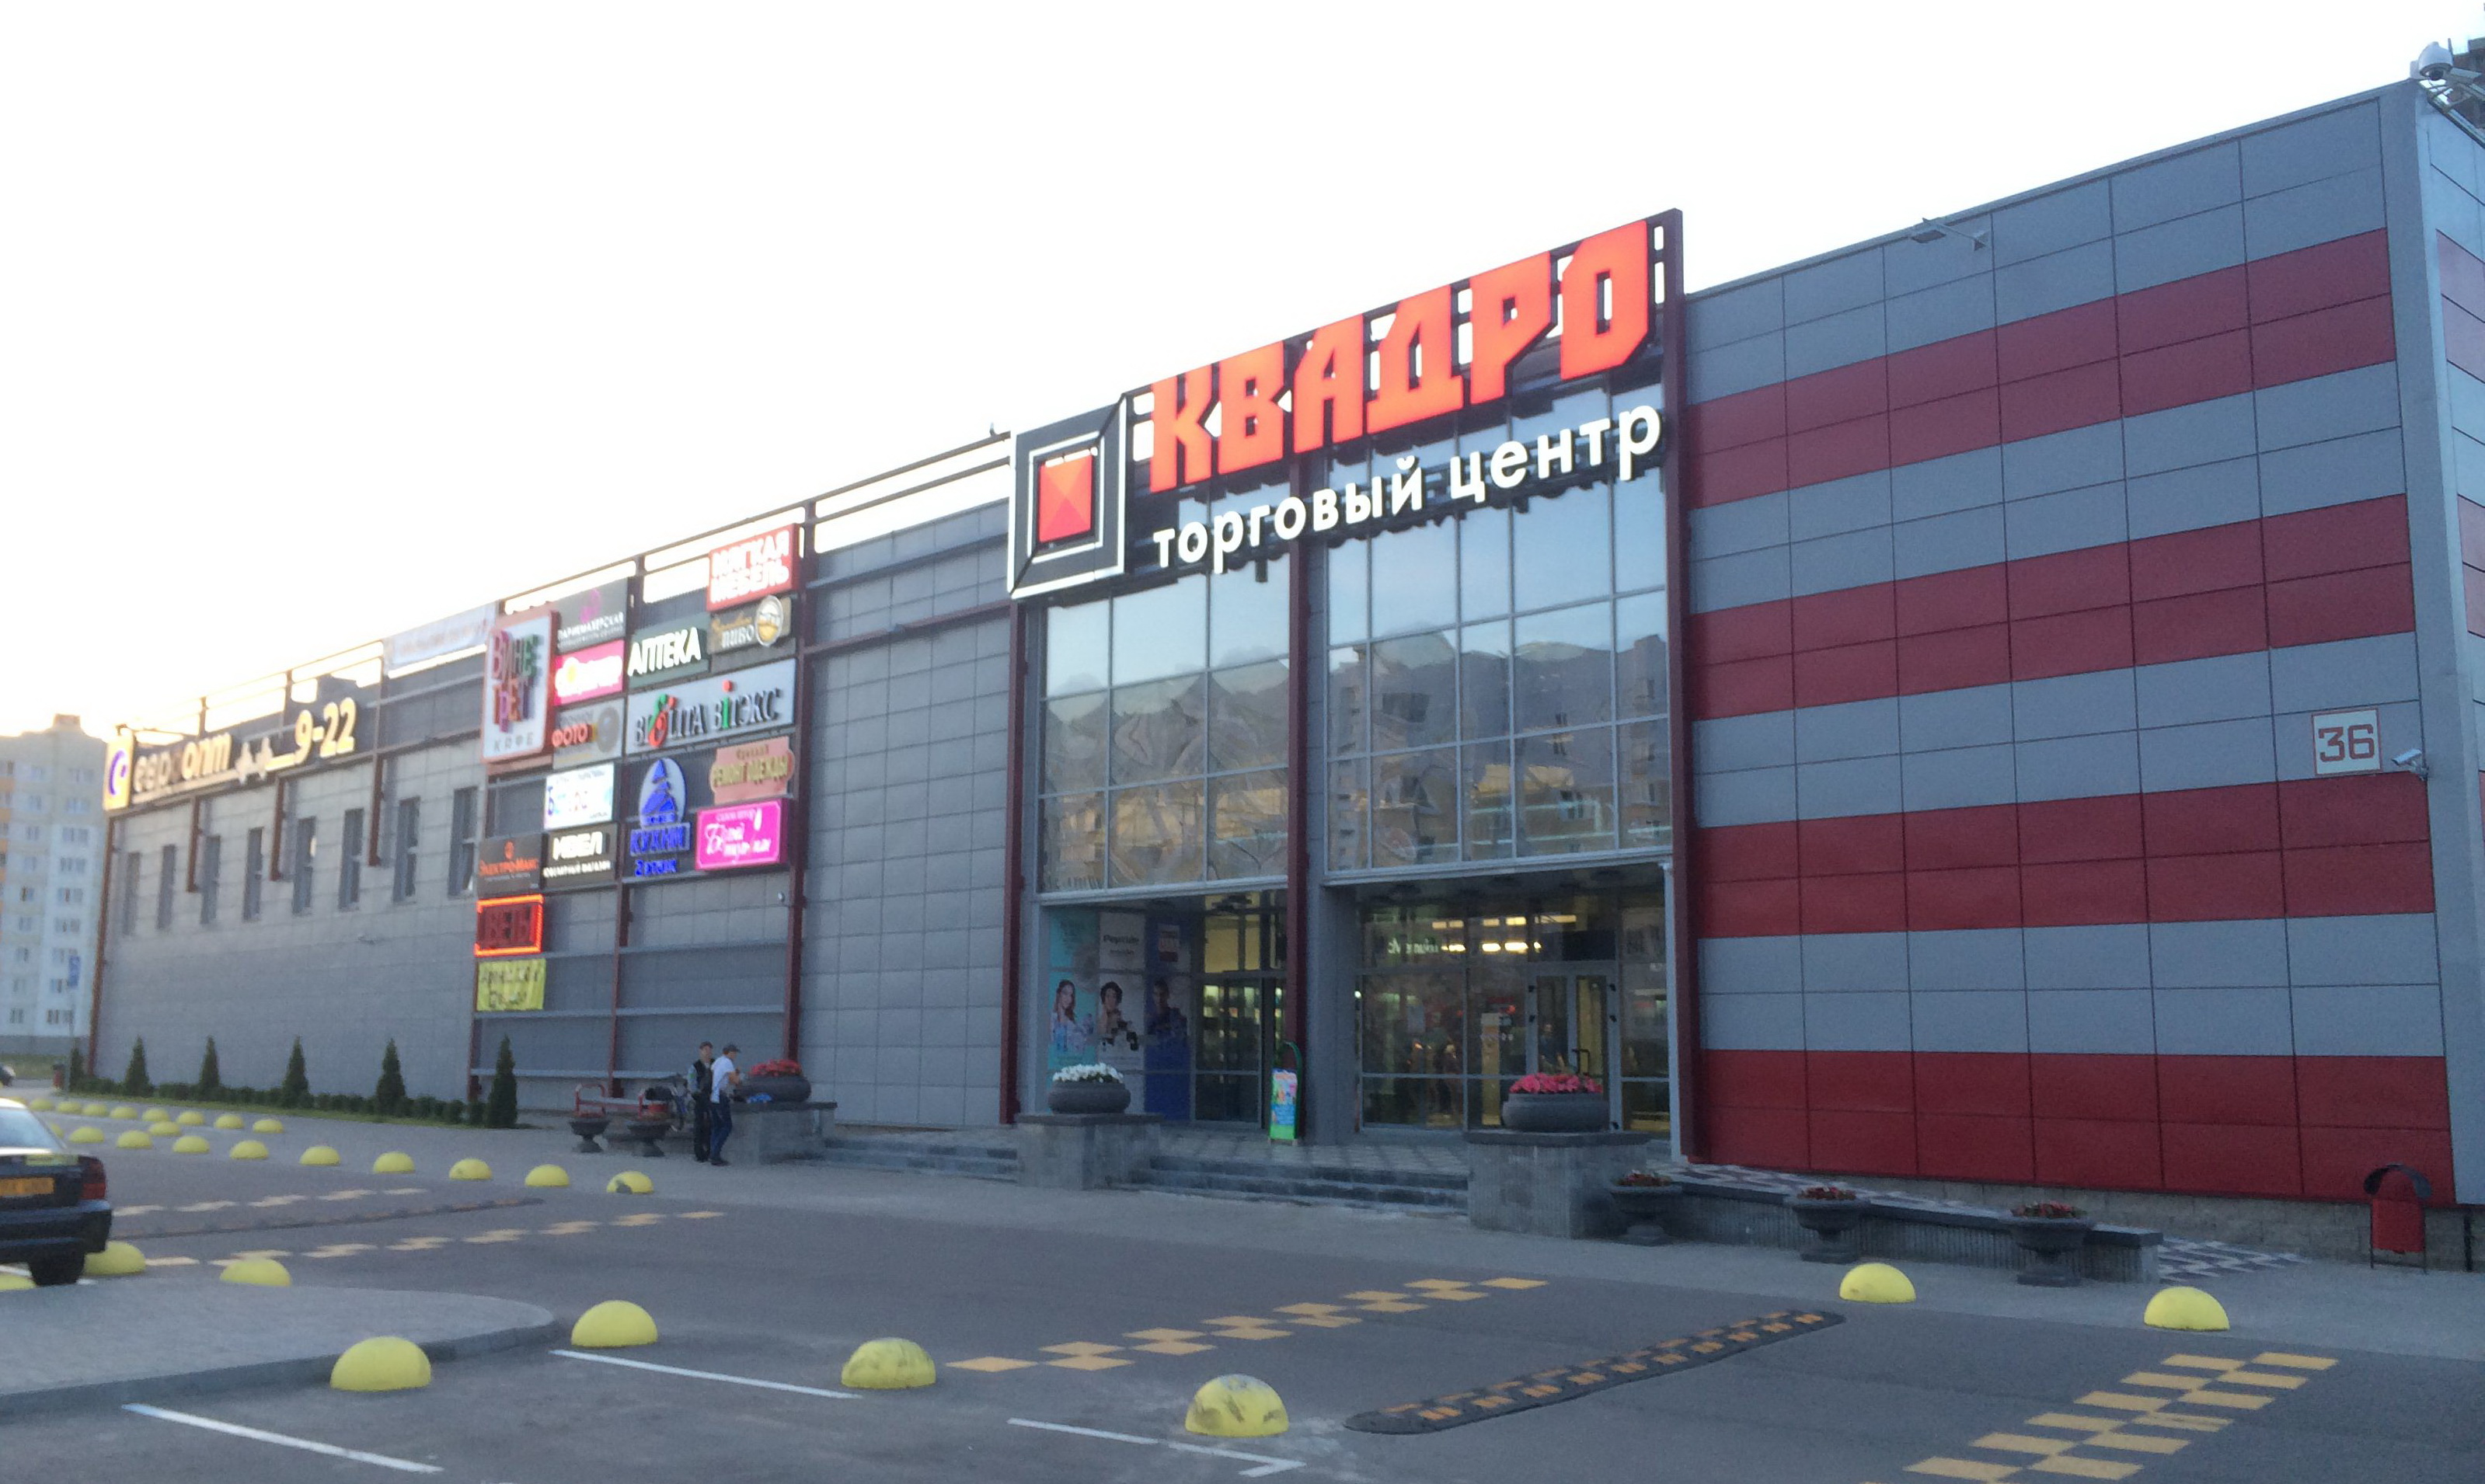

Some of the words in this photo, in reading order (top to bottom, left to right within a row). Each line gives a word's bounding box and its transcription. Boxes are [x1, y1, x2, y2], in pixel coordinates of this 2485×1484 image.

[1149, 219, 1647, 493] КВАДРО
[1153, 458, 1424, 573] торговый
[1451, 404, 1661, 498] центр
[627, 626, 702, 676] АПТЕКА
[295, 696, 357, 765] 9-22
[552, 723, 588, 747] ФОТО
[2318, 723, 2375, 762] 36
[630, 826, 685, 854] КУХНИ
